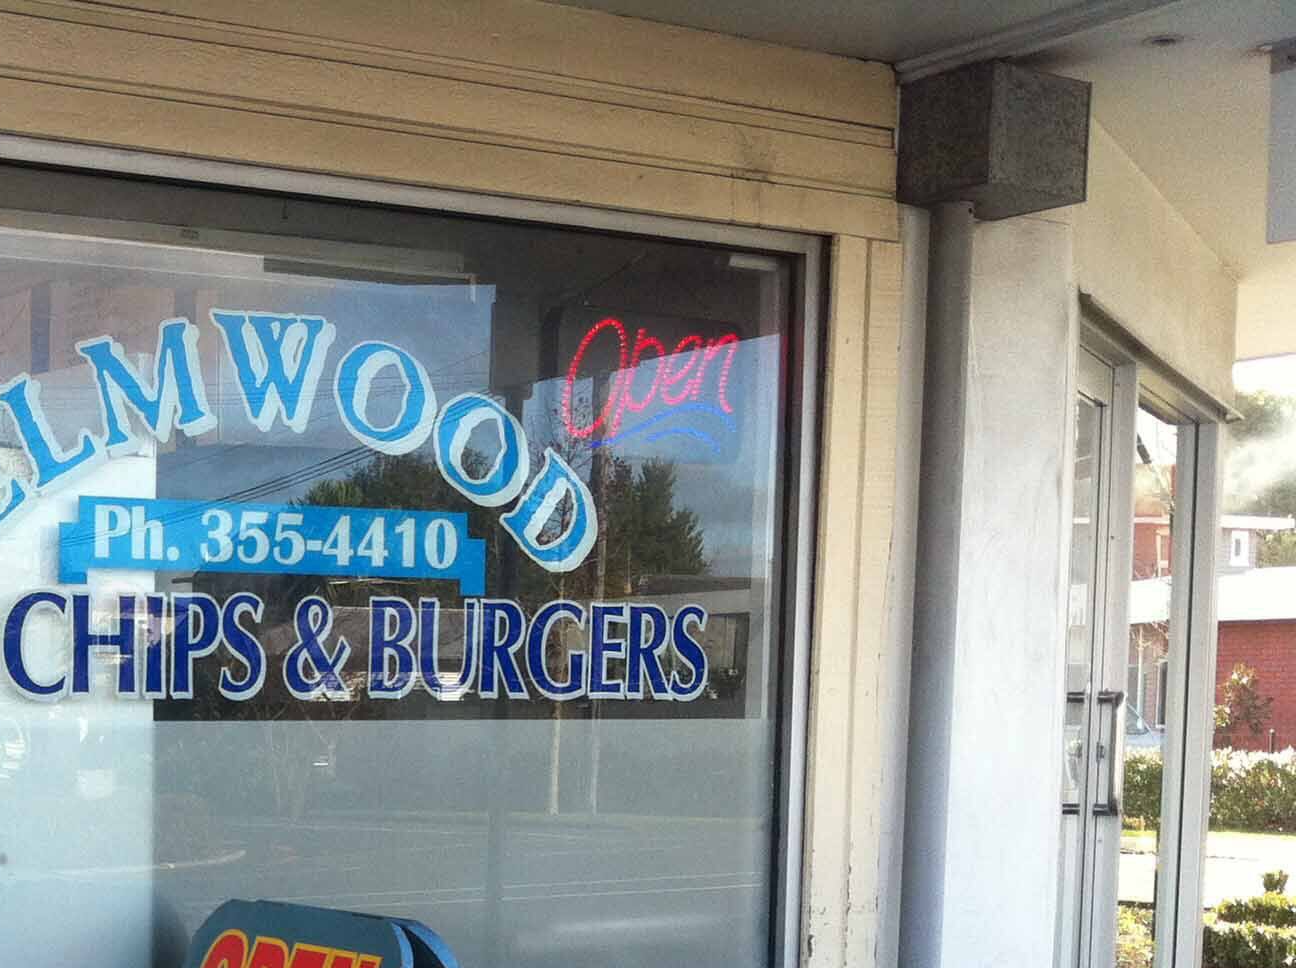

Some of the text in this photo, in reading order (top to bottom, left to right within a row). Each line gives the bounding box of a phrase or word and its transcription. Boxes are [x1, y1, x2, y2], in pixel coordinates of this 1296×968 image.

[562, 317, 740, 438] Open
[93, 504, 459, 571] Ph. 355-4410
[3, 590, 266, 701] CHIPS
[283, 594, 353, 701] &
[367, 595, 709, 702] BURGERS
